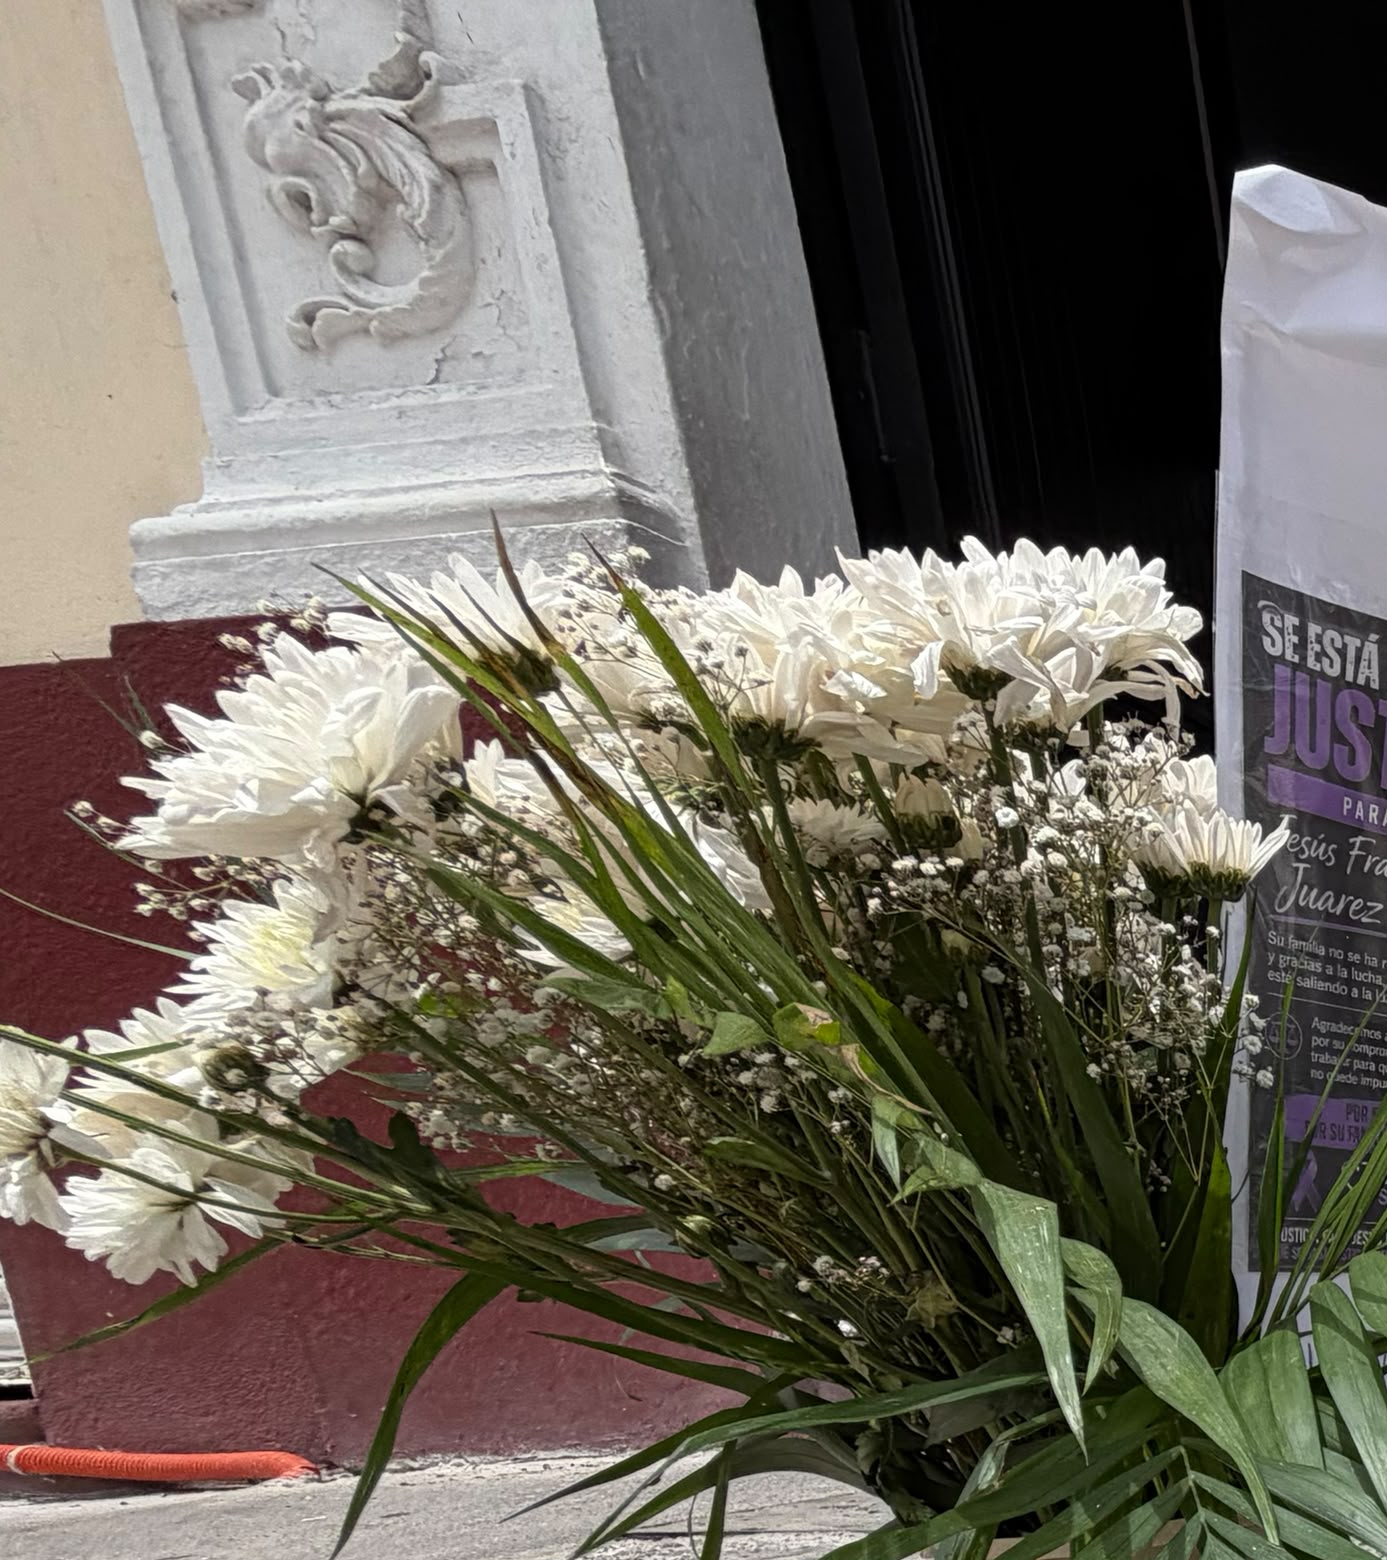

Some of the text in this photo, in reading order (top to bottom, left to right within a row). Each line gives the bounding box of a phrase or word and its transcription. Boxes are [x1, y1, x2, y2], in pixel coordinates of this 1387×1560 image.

[1261, 606, 1300, 664] SE
[1307, 620, 1379, 690] ESTÁ
[1274, 862, 1385, 924] Juarez
[1268, 930, 1285, 946] Su
[1288, 934, 1326, 956] familia
[1329, 947, 1345, 960] no
[1347, 952, 1361, 964] se
[1364, 952, 1379, 968] ha
[1267, 952, 1276, 966] y
[1279, 954, 1323, 973] gracias
[1325, 964, 1334, 976] a
[1337, 963, 1349, 979] la
[1351, 967, 1386, 987] lucha,
[1296, 975, 1348, 995] saliendo
[1351, 986, 1359, 998] a
[1362, 986, 1373, 1001] la
[1311, 1016, 1383, 1041] Agradecmos
[1311, 1035, 1330, 1049] por
[1311, 1051, 1352, 1067] trabar
[1353, 1059, 1376, 1072] para
[1310, 1068, 1325, 1080] no
[1326, 1071, 1358, 1085] qede
